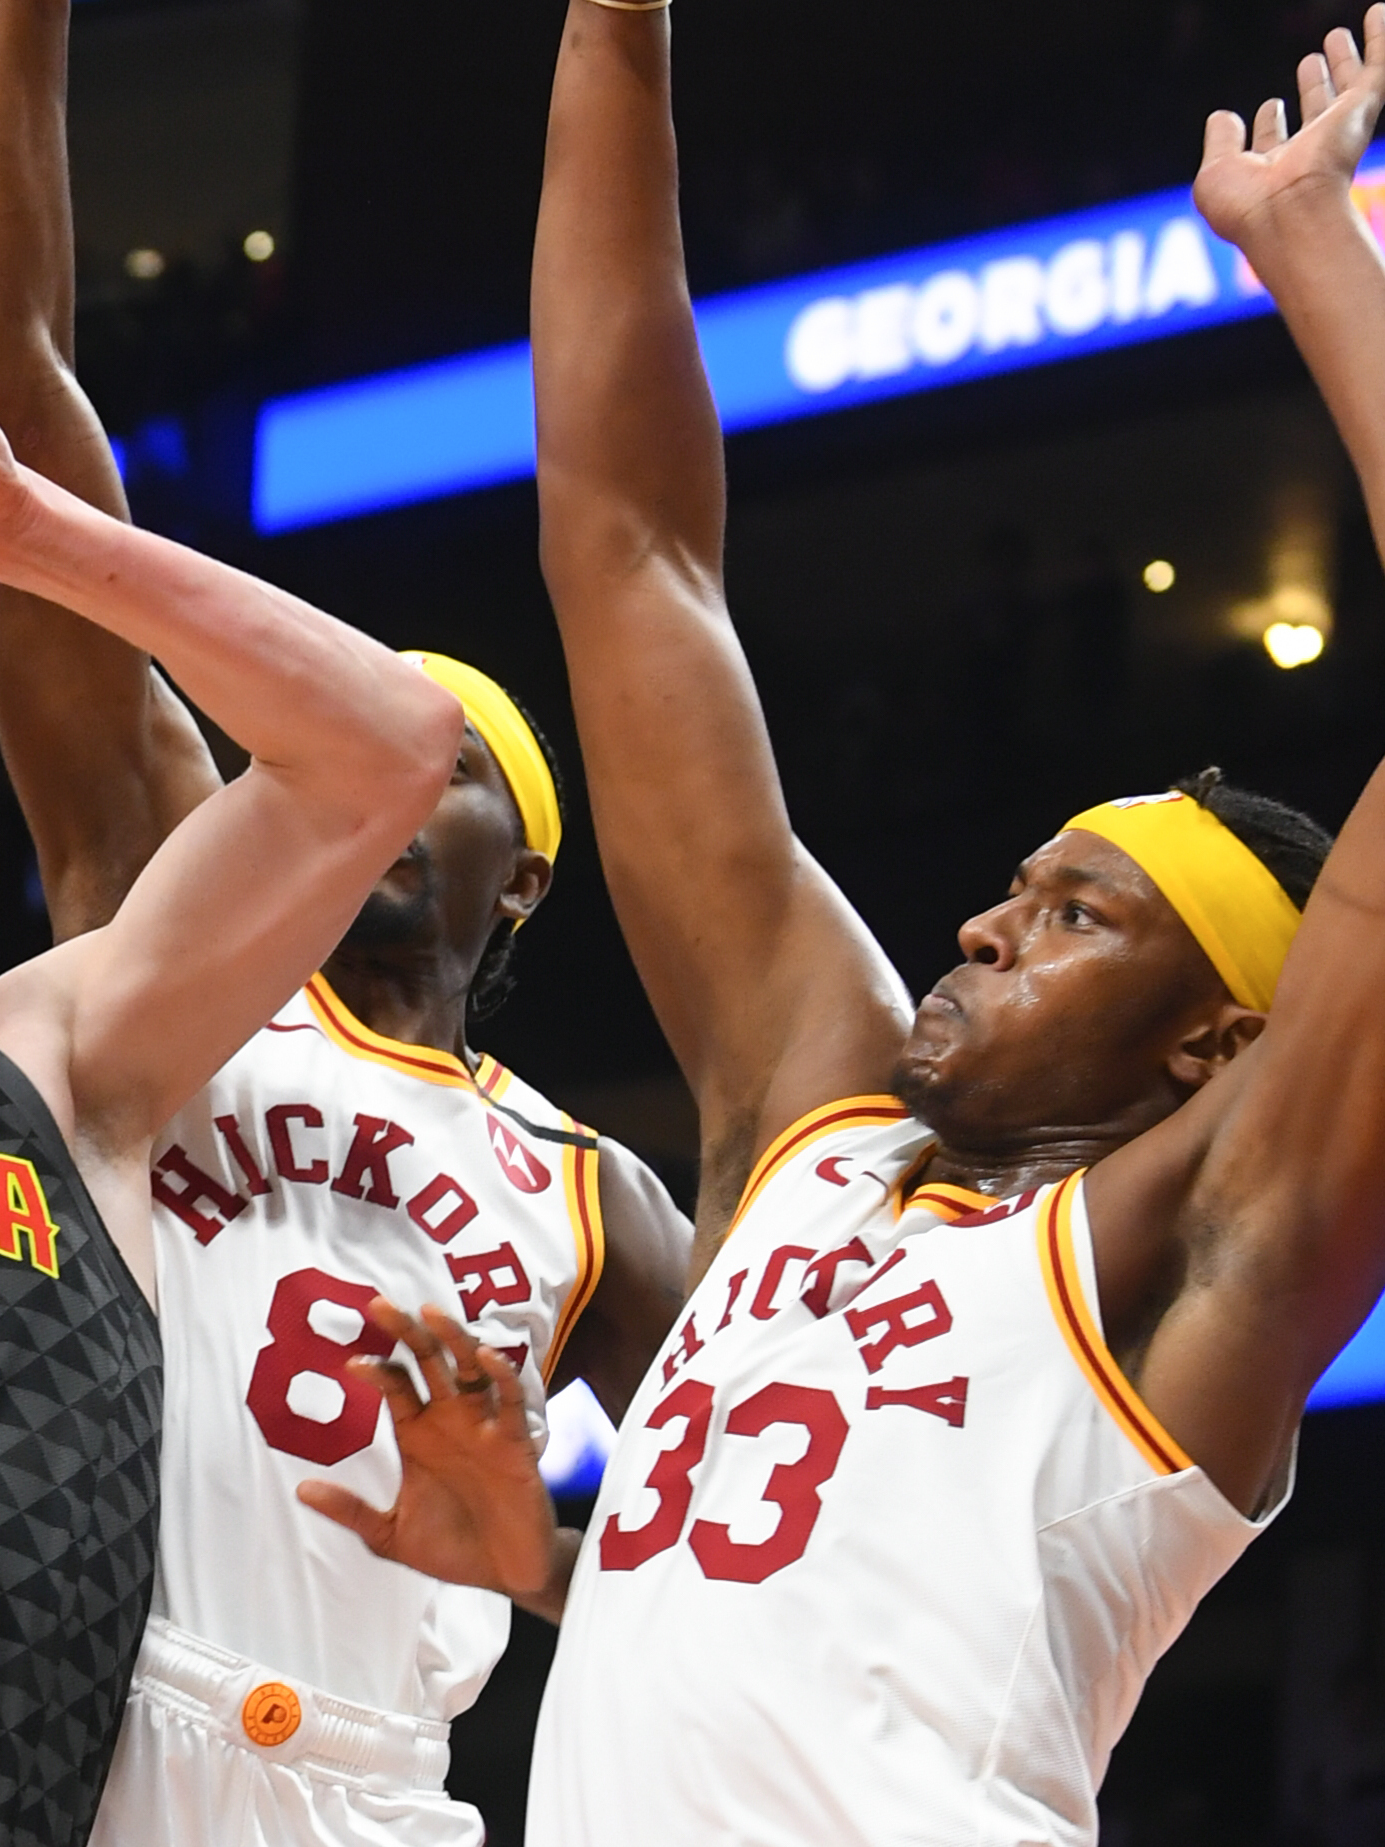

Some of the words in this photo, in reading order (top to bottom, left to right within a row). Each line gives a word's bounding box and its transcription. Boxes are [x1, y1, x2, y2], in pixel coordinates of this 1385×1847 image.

[785, 215, 1219, 394] GEORGIA
[245, 1267, 400, 1466] 8
[599, 1379, 851, 1584] 33
